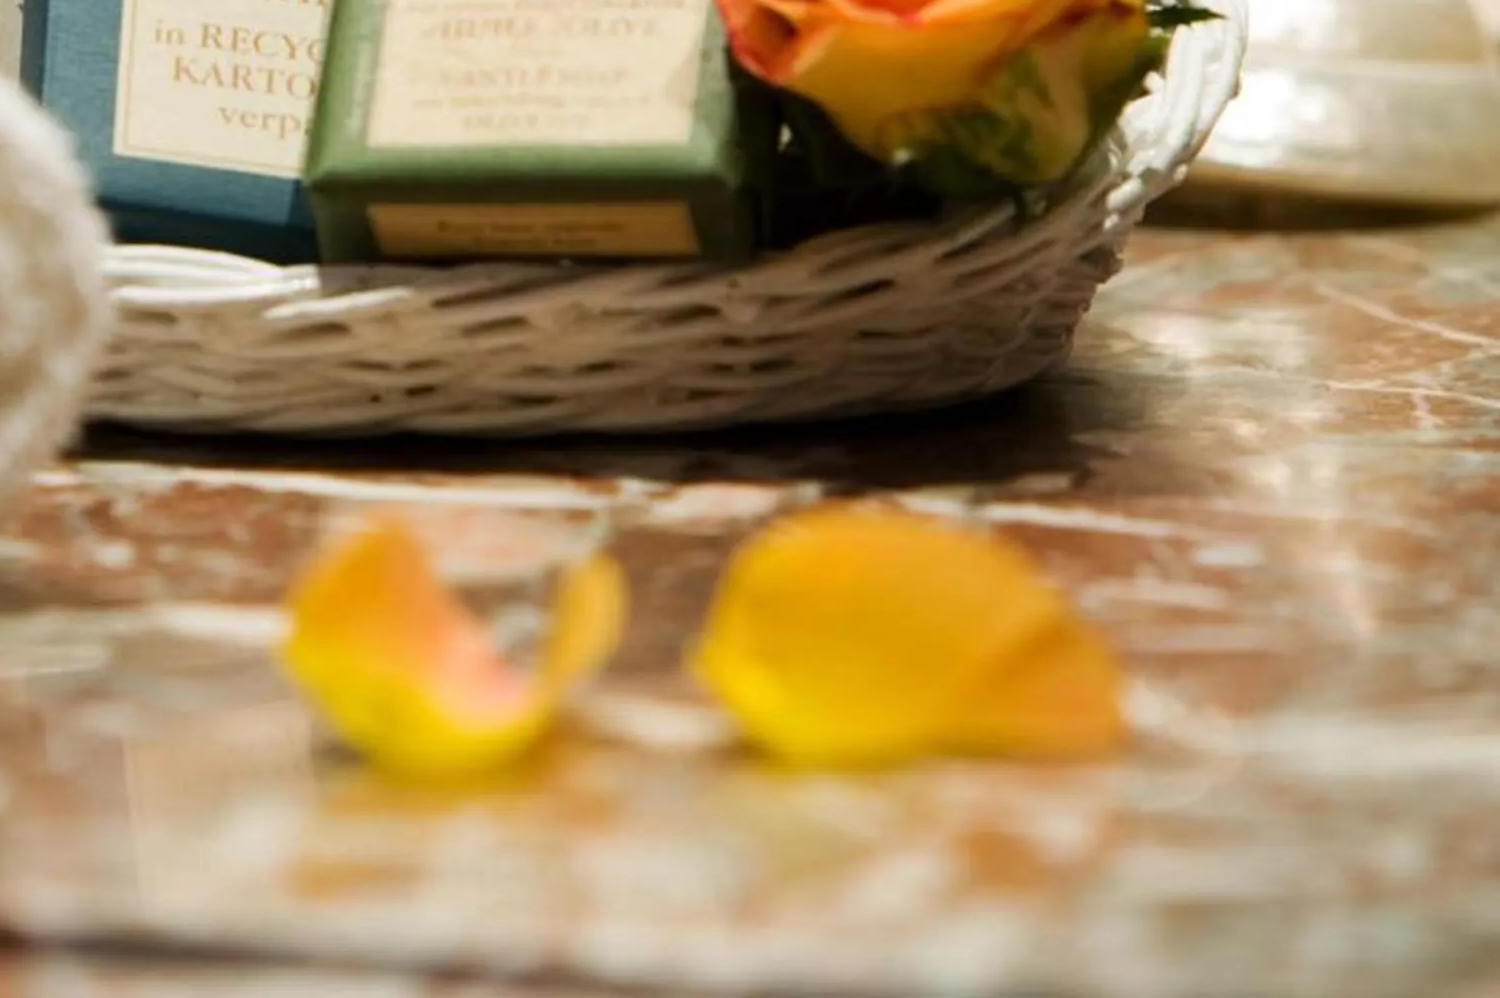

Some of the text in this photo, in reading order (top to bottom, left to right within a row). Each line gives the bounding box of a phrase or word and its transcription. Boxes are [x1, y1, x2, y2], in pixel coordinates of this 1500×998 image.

[155, 17, 186, 46] in
[172, 55, 316, 101] KARTO
[218, 105, 312, 141] verp
